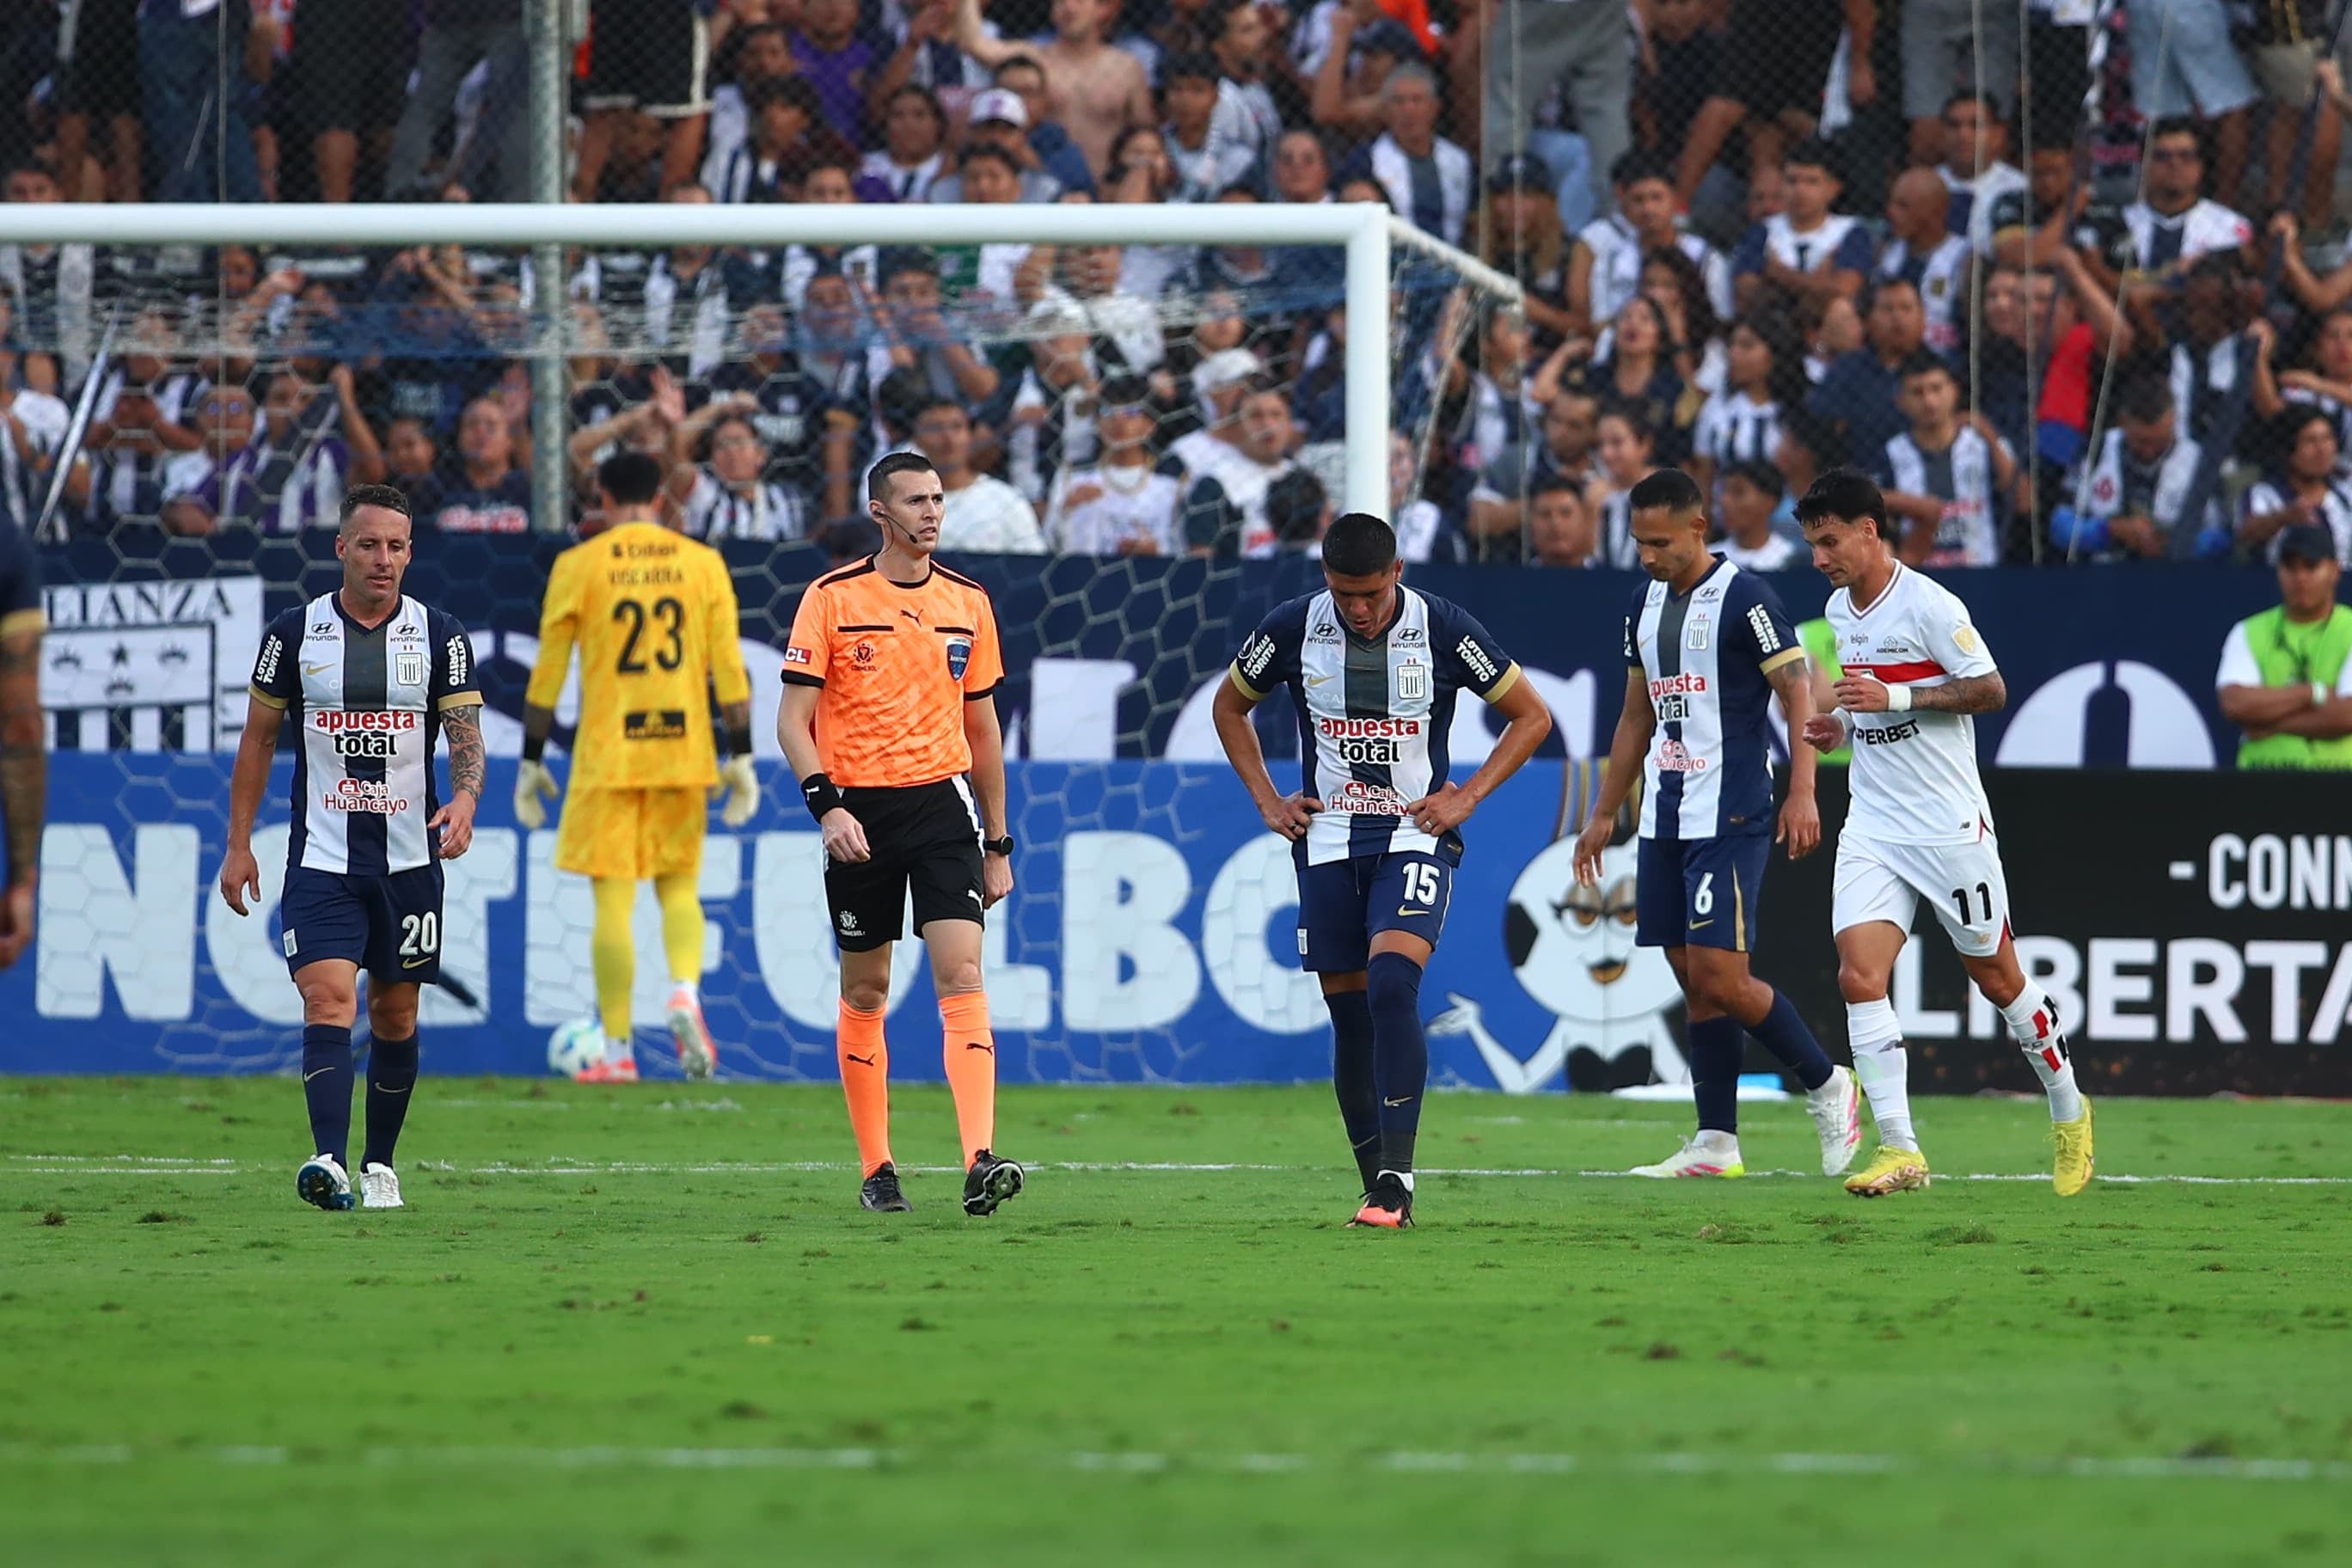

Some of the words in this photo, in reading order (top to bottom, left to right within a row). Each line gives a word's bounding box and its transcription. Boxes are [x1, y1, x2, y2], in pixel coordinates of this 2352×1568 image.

[613, 596, 685, 675] 23
[1747, 607, 1772, 653] TORITO
[262, 640, 283, 684] TORITO
[446, 637, 460, 687] TORITO
[1247, 642, 1276, 679] TORITO
[1455, 641, 1490, 683] TORITO
[315, 709, 416, 733] apuesta
[1320, 717, 1419, 739] apuesta
[335, 734, 398, 756] total
[1338, 740, 1400, 763] total
[324, 793, 408, 816] Huancayo
[362, 781, 389, 795] Caja
[1331, 795, 1410, 817] Huancay
[1369, 785, 1400, 800] Caja
[1402, 861, 1441, 906] 15
[1694, 871, 1714, 916] 6
[1951, 881, 1993, 926] 11
[399, 910, 438, 956] 20
